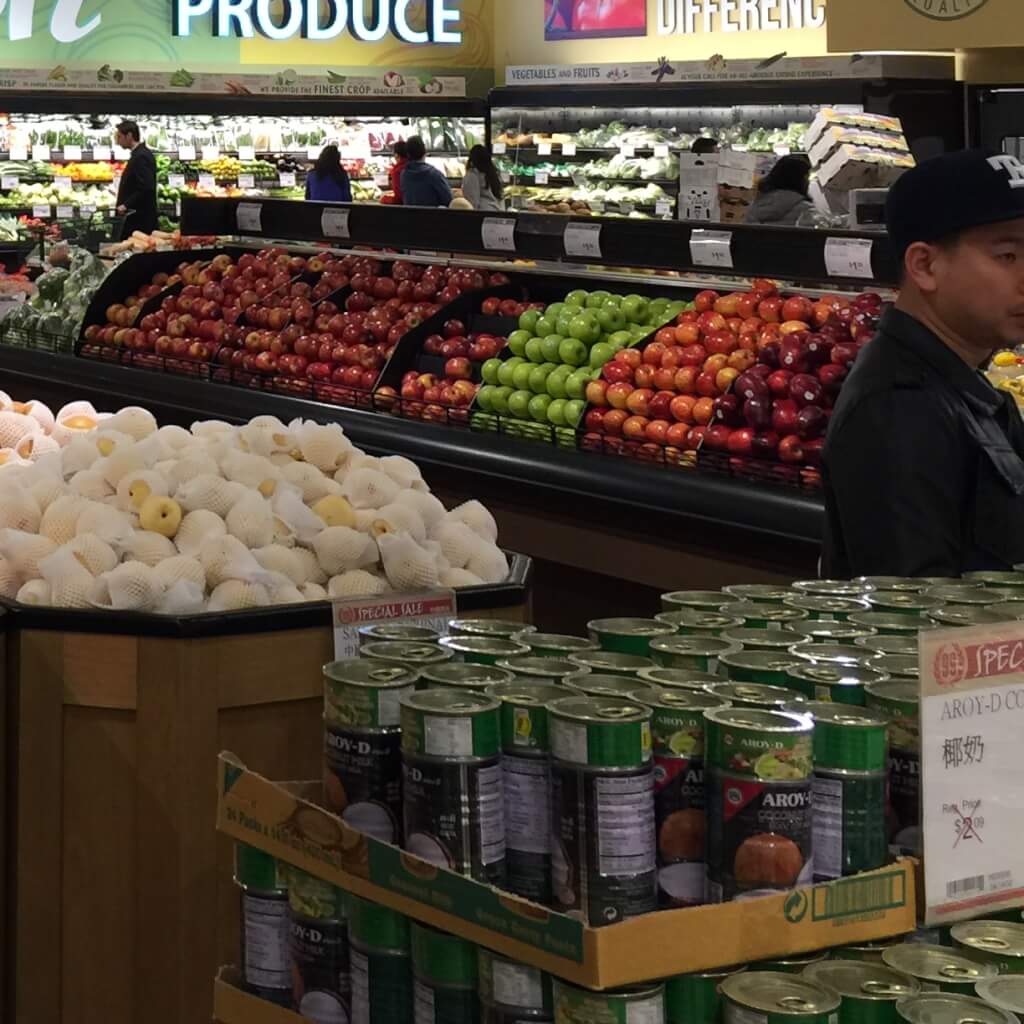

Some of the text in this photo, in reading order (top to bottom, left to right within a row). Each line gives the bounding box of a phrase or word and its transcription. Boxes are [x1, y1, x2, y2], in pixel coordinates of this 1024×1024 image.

[511, 67, 557, 80] VEGETABLES
[573, 67, 601, 78] FRUITS
[314, 84, 344, 94] FINEST
[346, 85, 371, 95] CROP
[358, 602, 424, 620] SPECIAL SALE
[939, 692, 1003, 721] AROY-D
[942, 734, 985, 769] 椰奶
